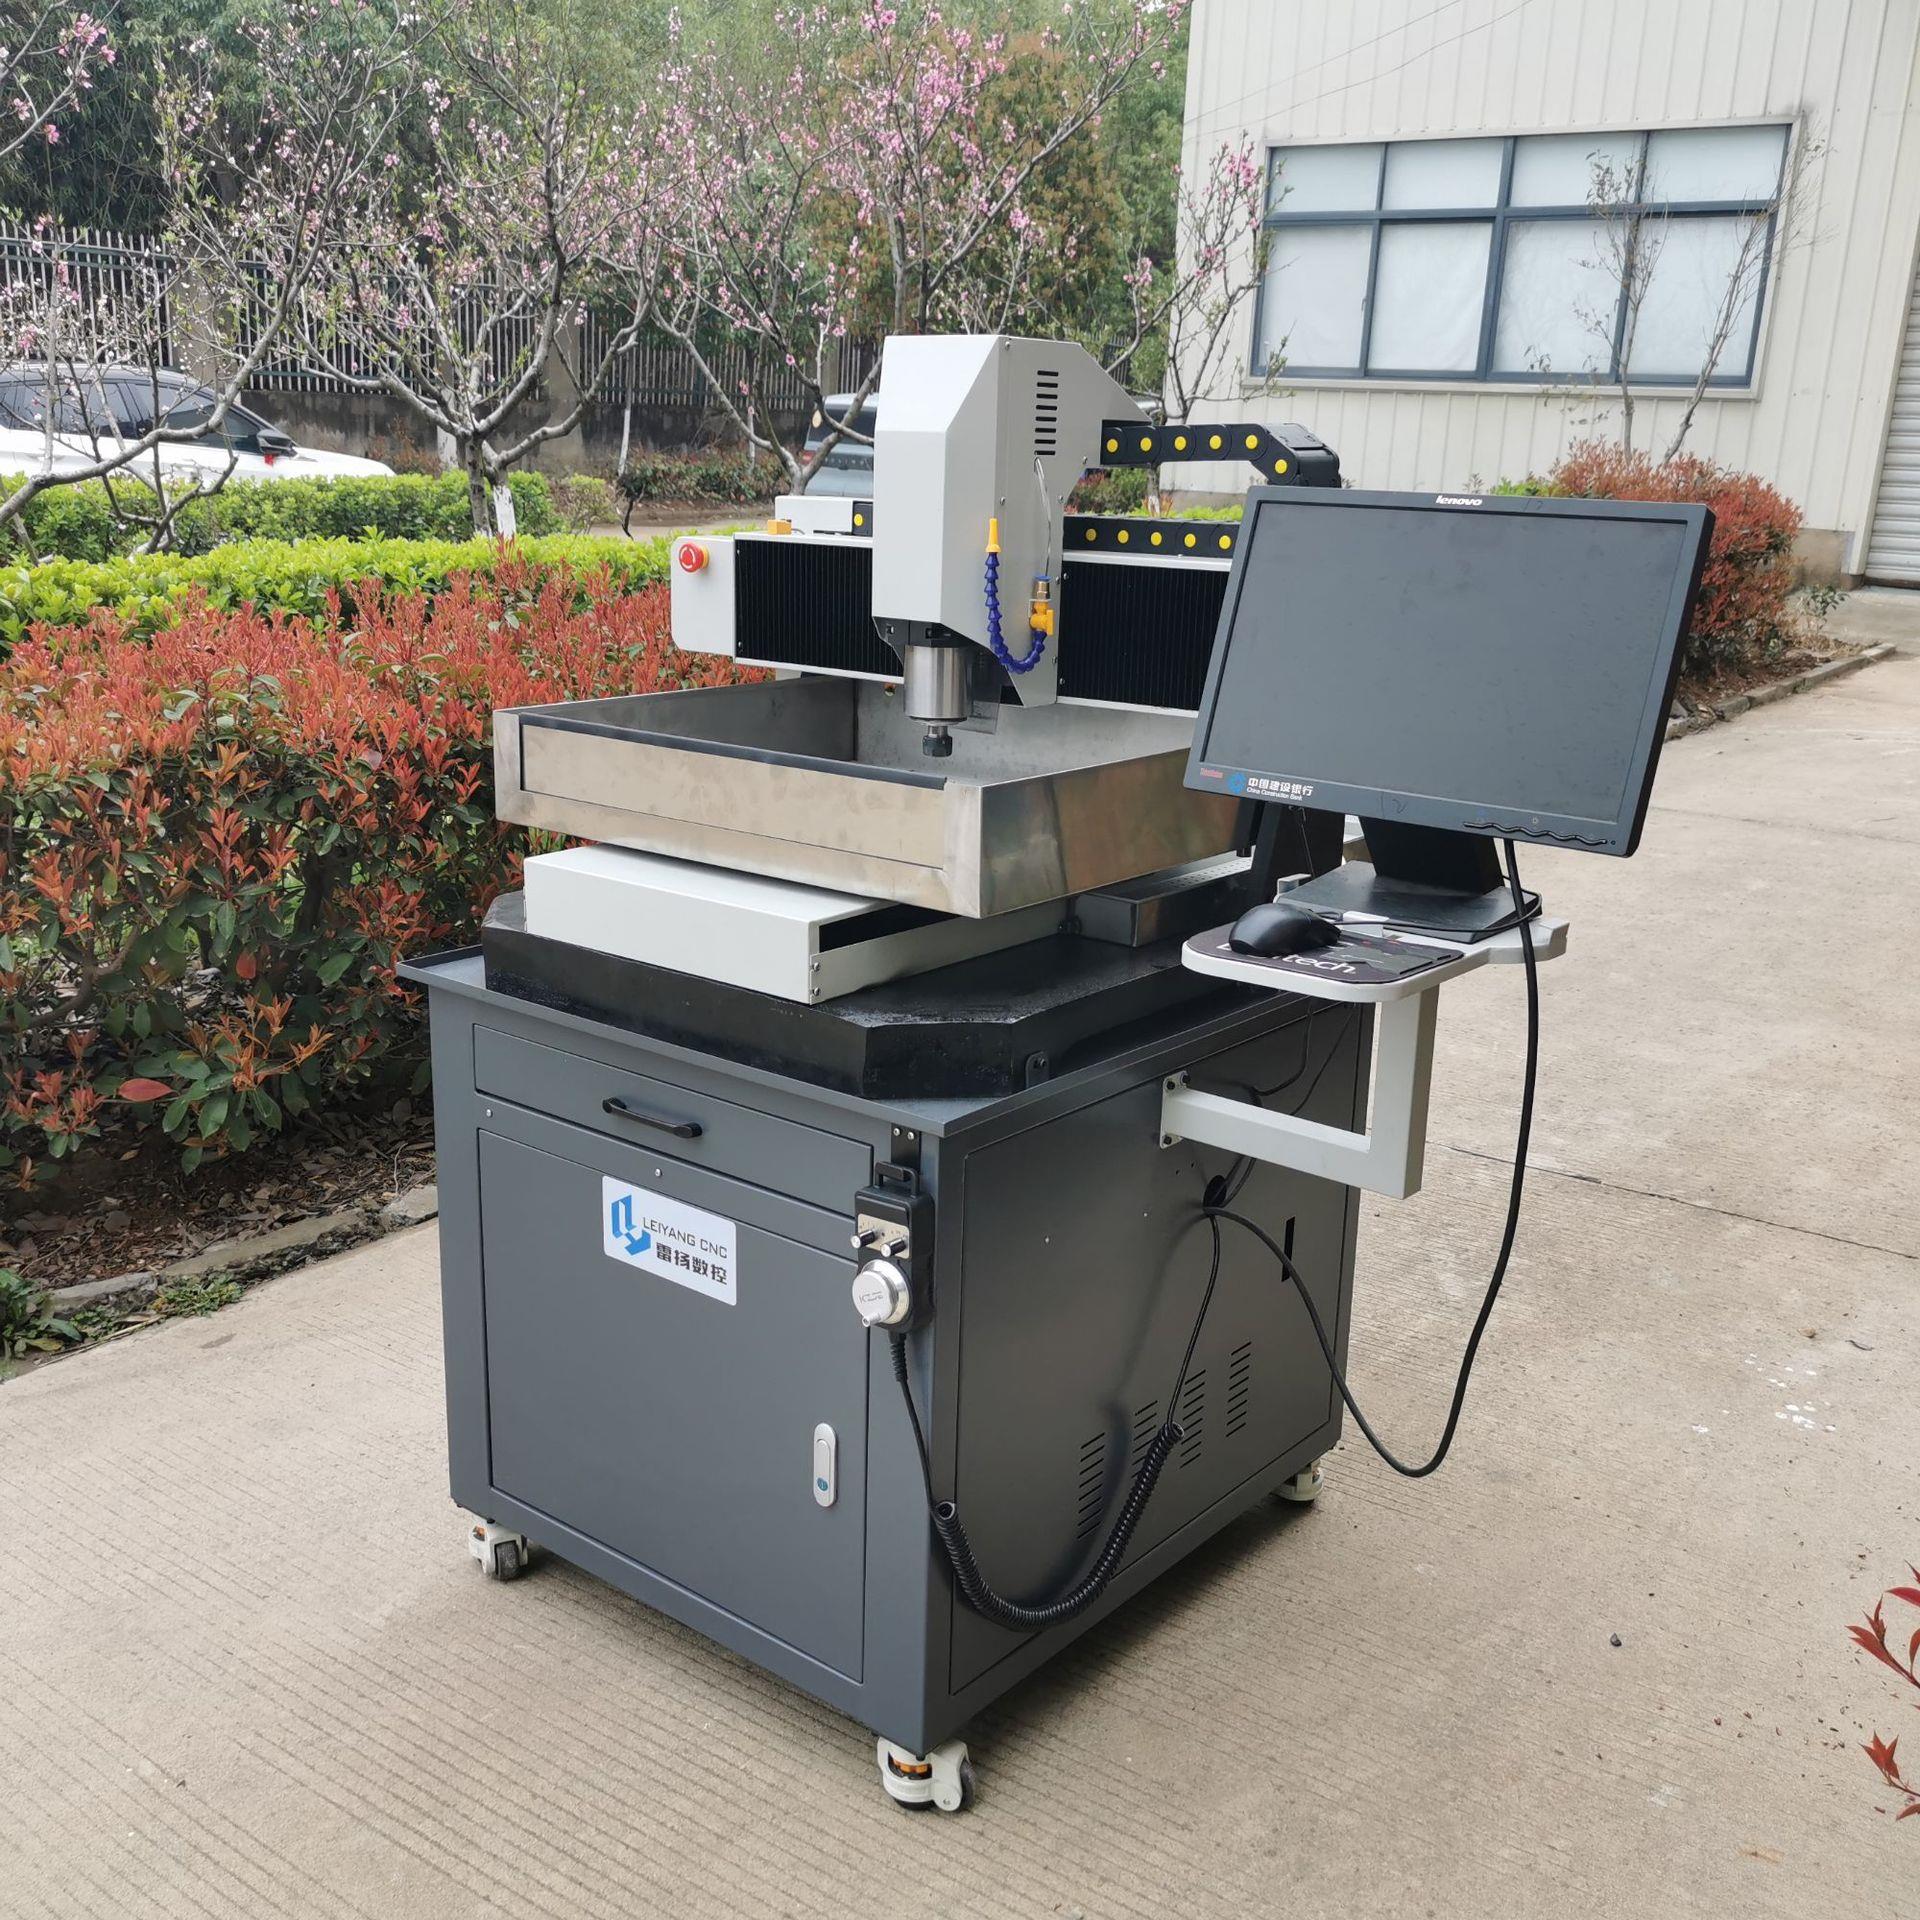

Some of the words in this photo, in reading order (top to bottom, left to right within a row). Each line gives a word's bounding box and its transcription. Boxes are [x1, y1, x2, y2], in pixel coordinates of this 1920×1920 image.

[1436, 495, 1483, 506] lenovo
[1248, 778, 1314, 796] 中国建设银行
[643, 1217, 696, 1247] LEIYANG
[700, 1238, 728, 1259] CNC
[656, 1242, 728, 1286] 雷扬数控
